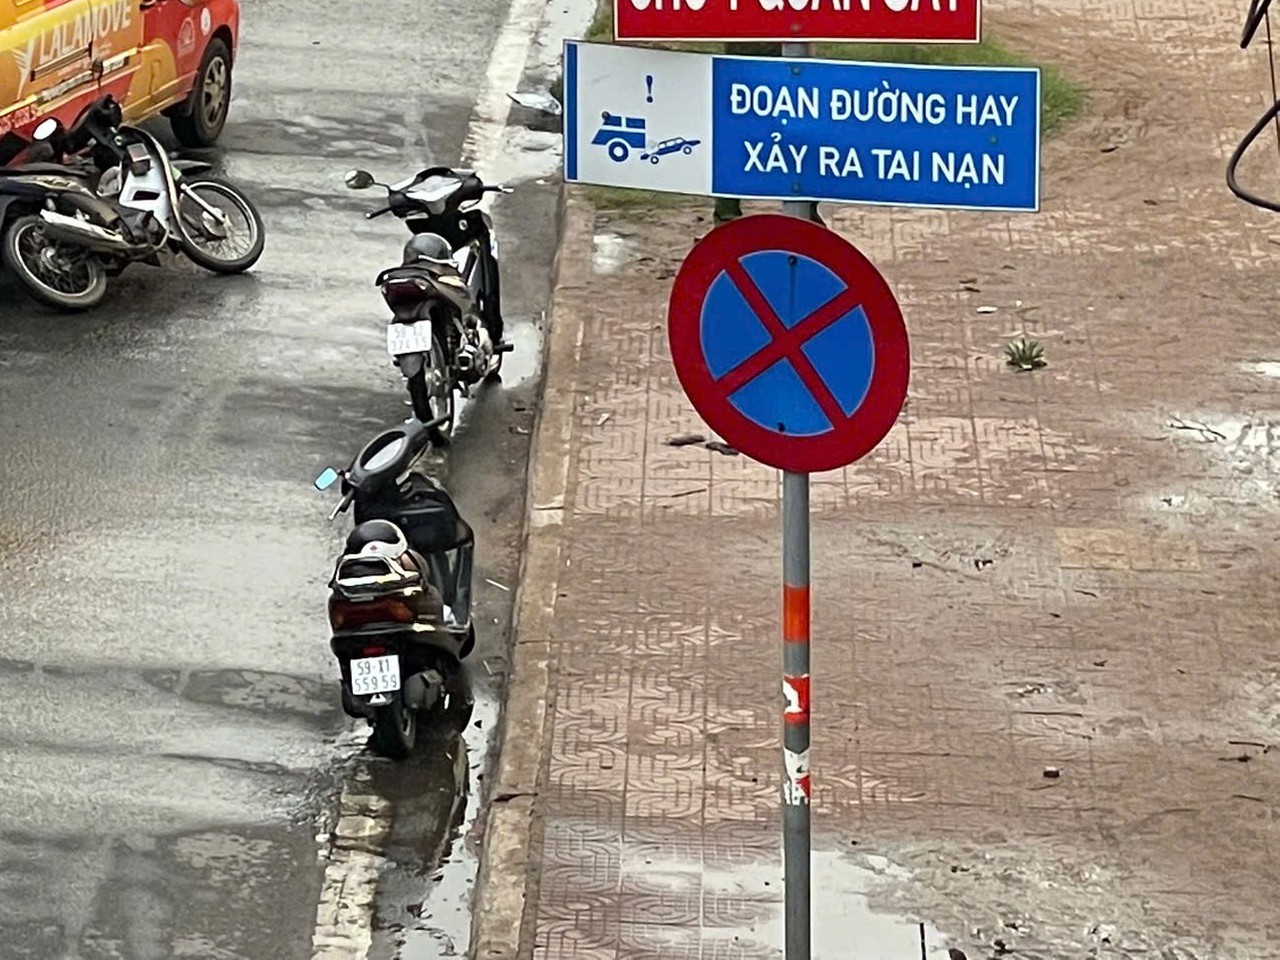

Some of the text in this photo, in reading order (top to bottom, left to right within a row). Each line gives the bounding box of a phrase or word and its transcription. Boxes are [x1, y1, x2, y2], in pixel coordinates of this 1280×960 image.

[730, 81, 1019, 127] ĐOẠN ĐƯỜNG HAY
[743, 132, 1005, 190] XẢY RA TAI NẠN
